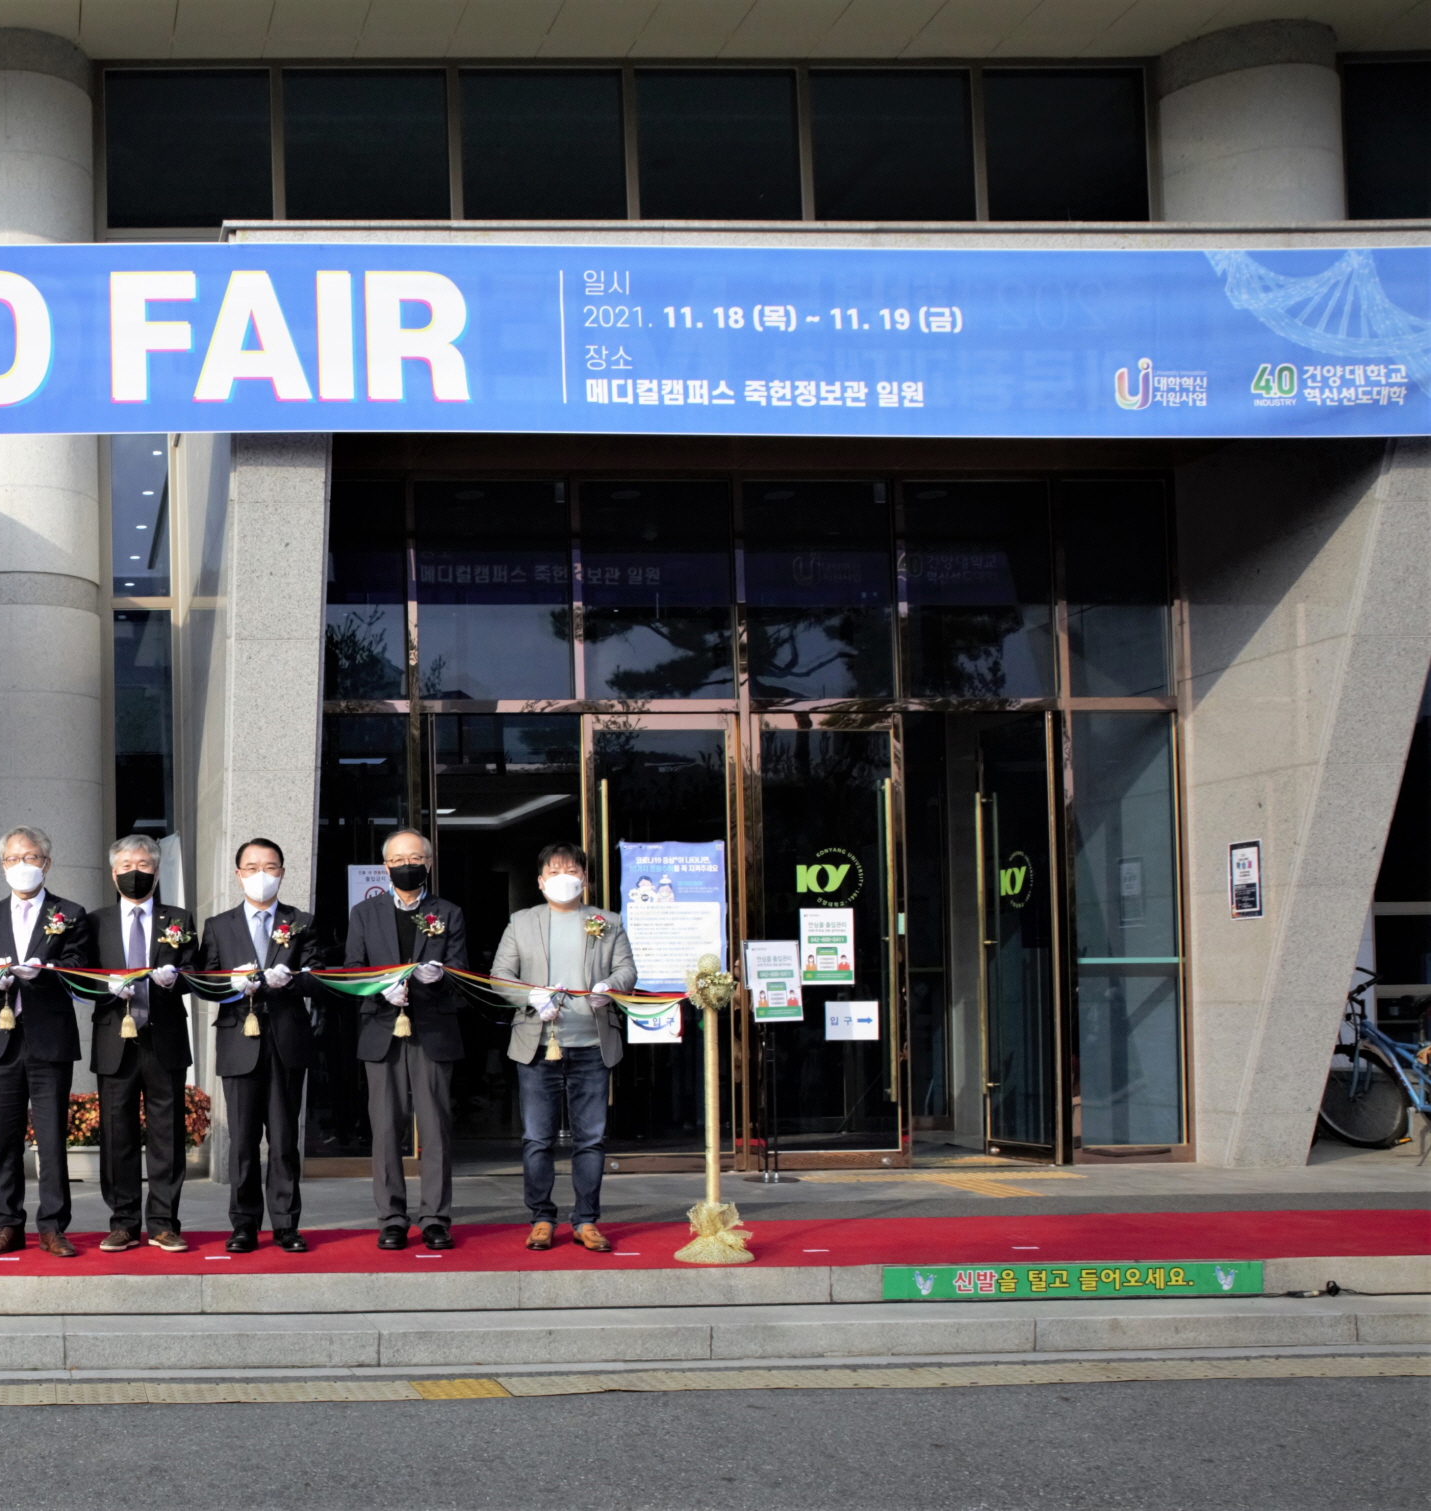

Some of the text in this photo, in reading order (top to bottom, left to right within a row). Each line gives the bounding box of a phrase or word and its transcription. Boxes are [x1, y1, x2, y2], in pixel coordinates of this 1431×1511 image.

[583, 269, 631, 296] 일시
[583, 305, 654, 329] 2021.
[664, 306, 704, 329] 11.
[713, 307, 745, 329] 18
[830, 308, 870, 330] 11.
[879, 308, 911, 330] 19
[109, 269, 471, 404] FAIR
[584, 345, 634, 371] 장소
[1153, 376, 1208, 391] 대학혁신
[1302, 364, 1409, 387] 건양대학교
[585, 378, 925, 408] 메디컬캠퍼스 죽헌정보관 일원
[1153, 391, 1208, 407] 지원사업
[1253, 398, 1297, 407] INDUSTRY
[1303, 385, 1407, 406] 혁신선도대학
[816, 848, 864, 887] KONYANG UNIVERSITY
[953, 1267, 1195, 1293] 신발을 털고 들어오세요.
